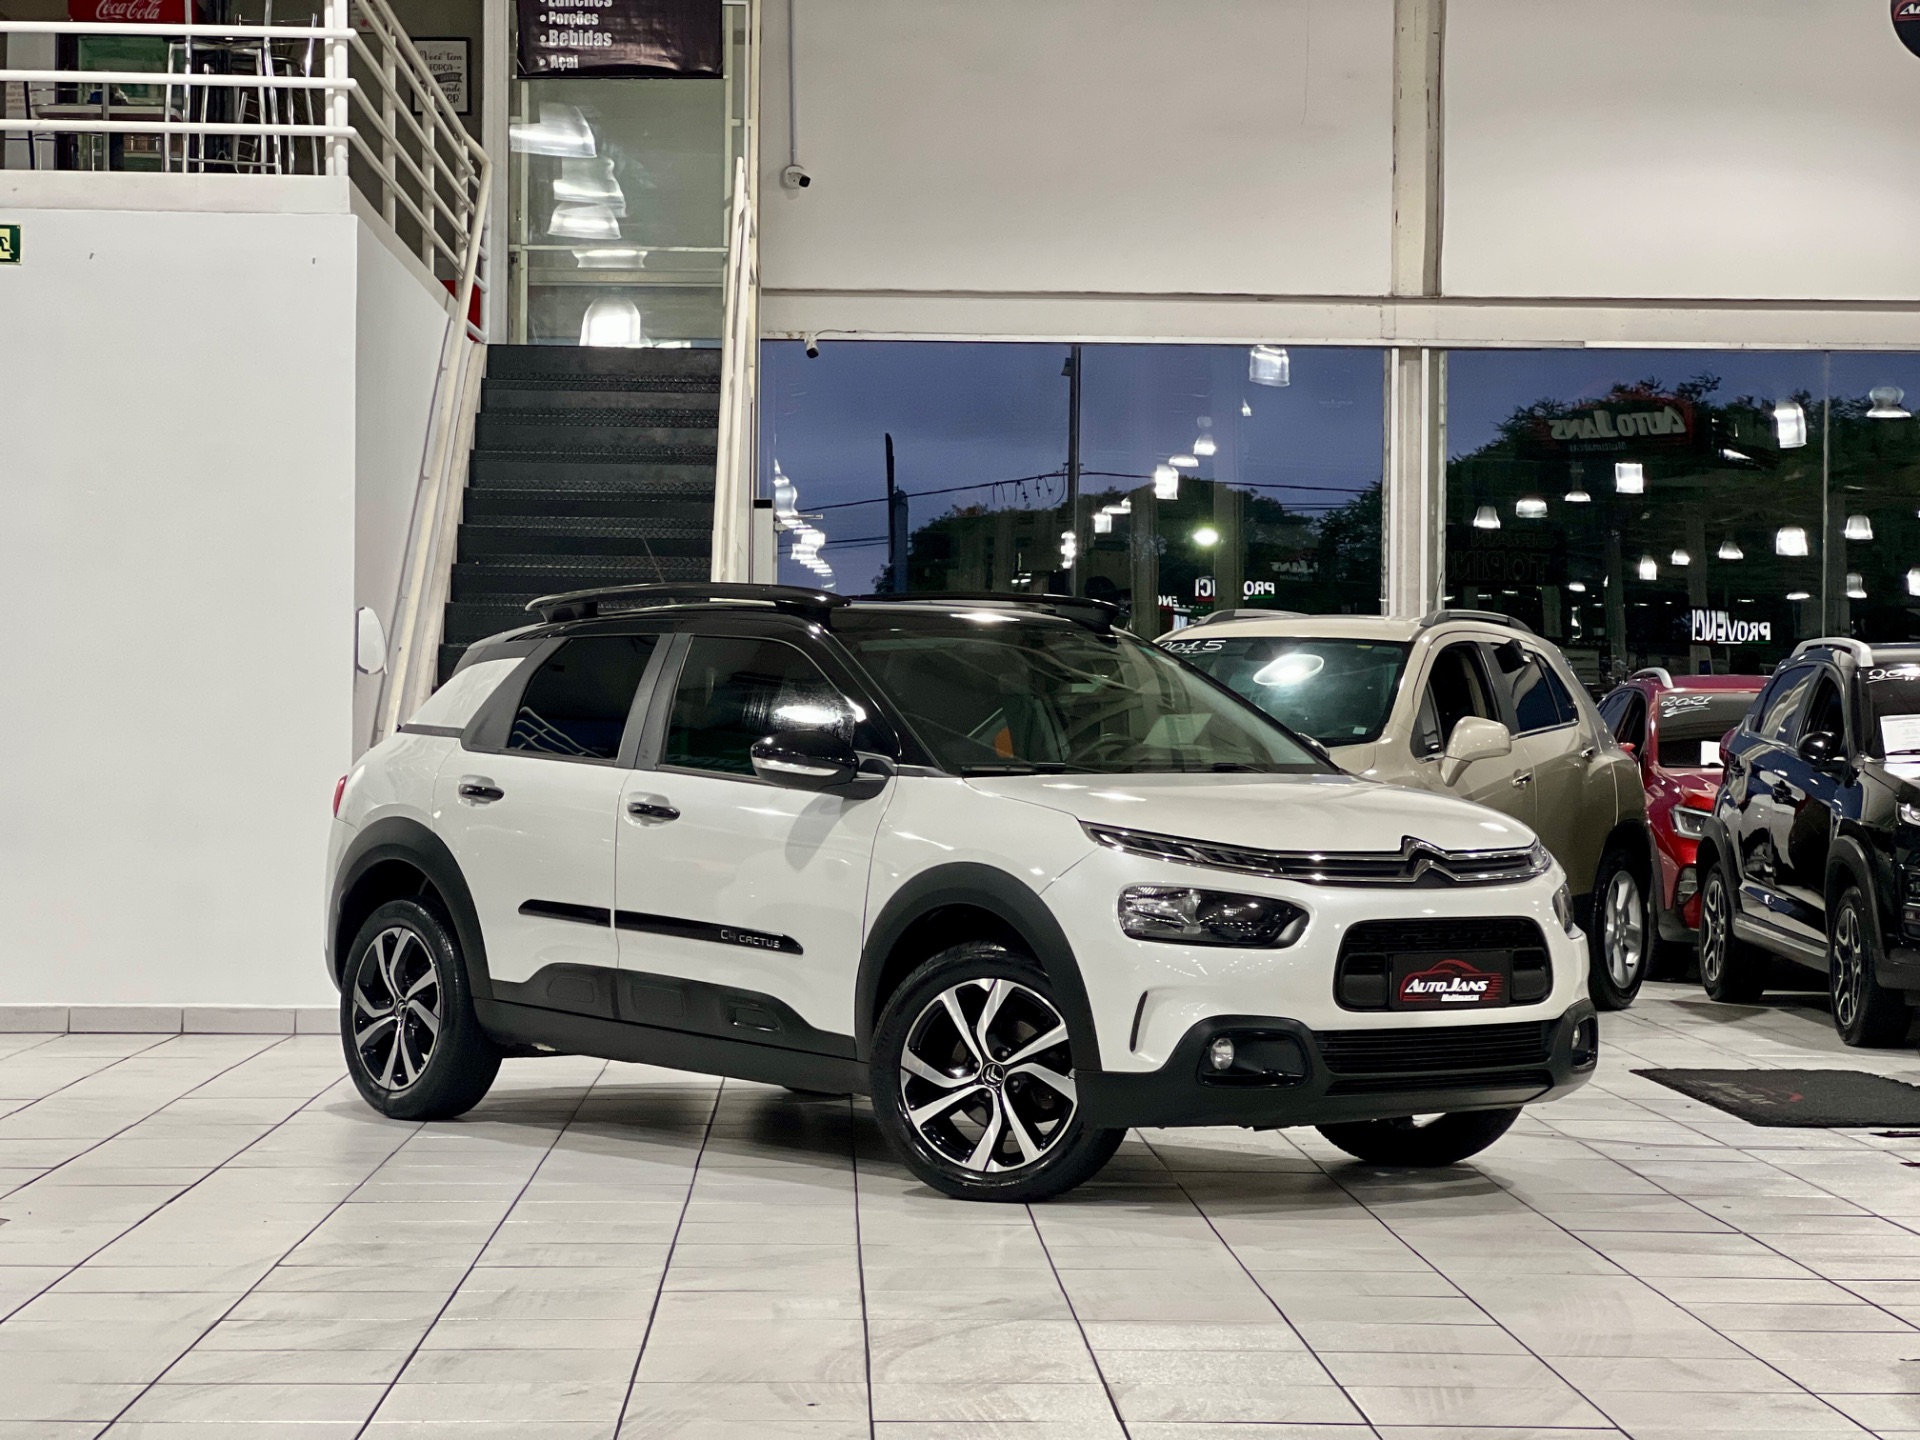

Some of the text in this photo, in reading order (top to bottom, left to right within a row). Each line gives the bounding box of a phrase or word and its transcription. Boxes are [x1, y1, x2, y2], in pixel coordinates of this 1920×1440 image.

[548, 11, 599, 28] Porções
[548, 29, 613, 47] Bebidas
[738, 935, 780, 948] CACTUS
